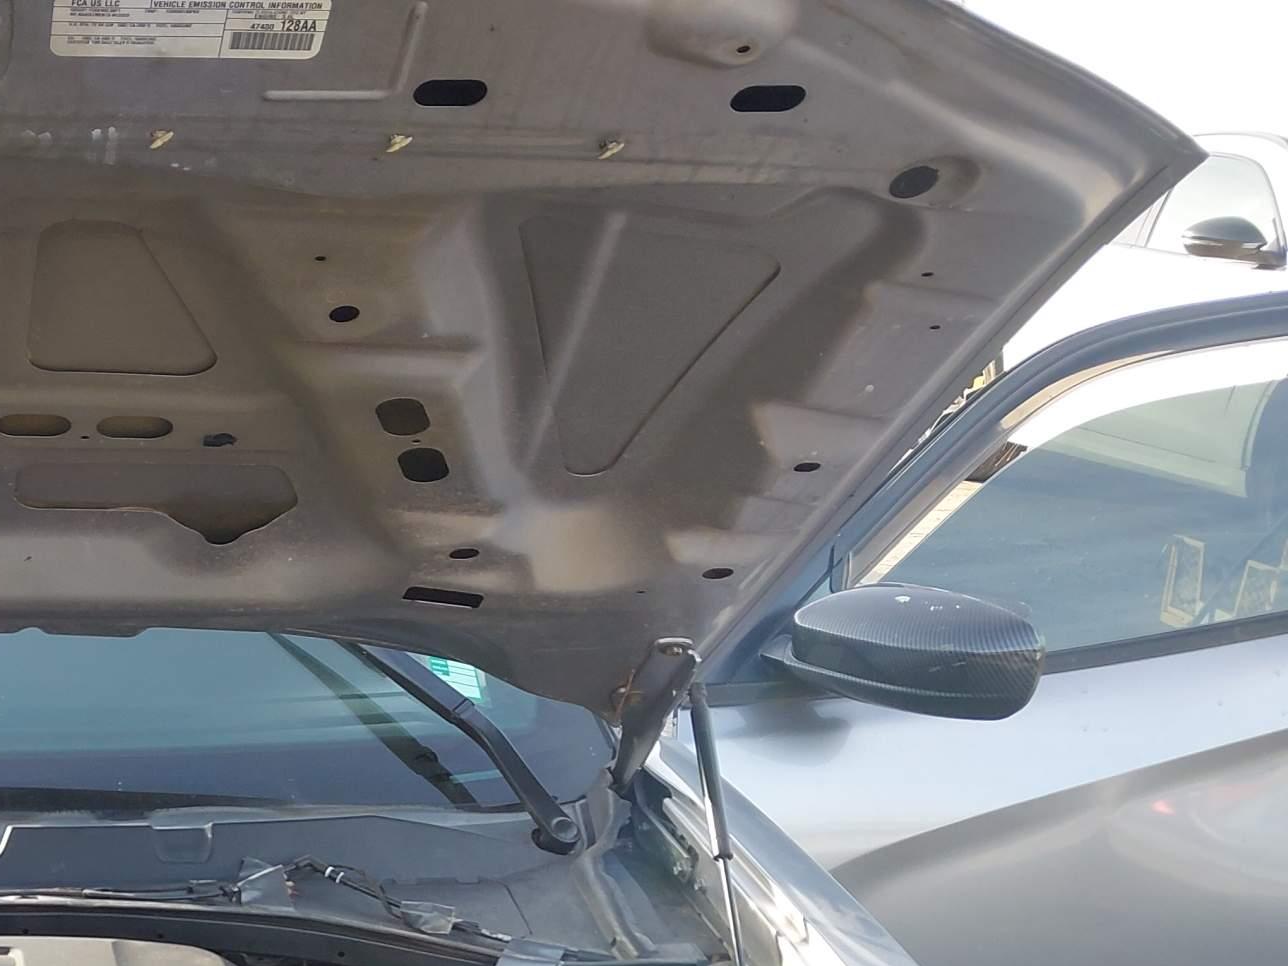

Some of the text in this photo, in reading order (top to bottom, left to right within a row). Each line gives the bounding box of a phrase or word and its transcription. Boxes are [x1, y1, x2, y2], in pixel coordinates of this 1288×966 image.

[188, 1, 226, 9] EMISSION
[229, 1, 264, 9] CONTROL
[281, 20, 316, 32] 128AA
